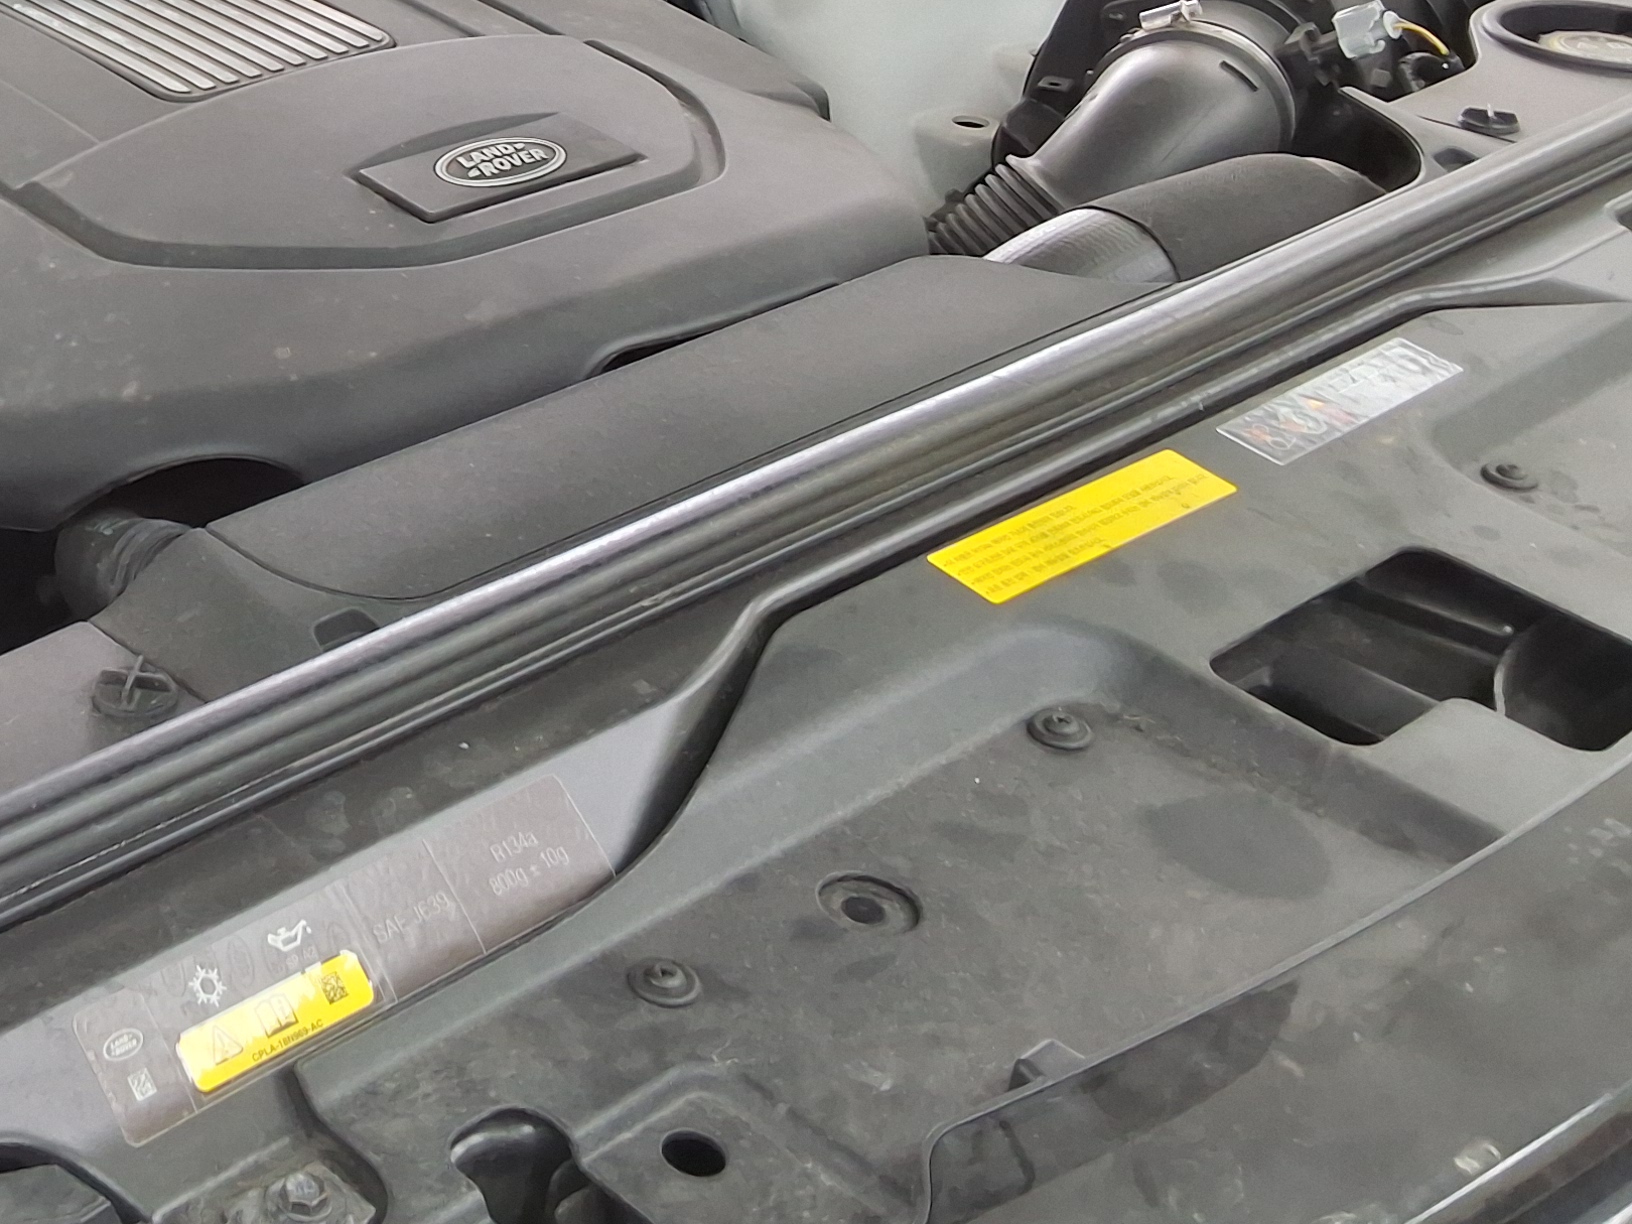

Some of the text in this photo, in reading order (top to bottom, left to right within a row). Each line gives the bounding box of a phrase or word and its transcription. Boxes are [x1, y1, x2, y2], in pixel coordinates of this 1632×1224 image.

[456, 142, 516, 167] LAND
[479, 148, 549, 177] ROVER
[489, 828, 539, 862] R134a
[488, 865, 529, 898] 800g
[539, 843, 570, 872] 10g
